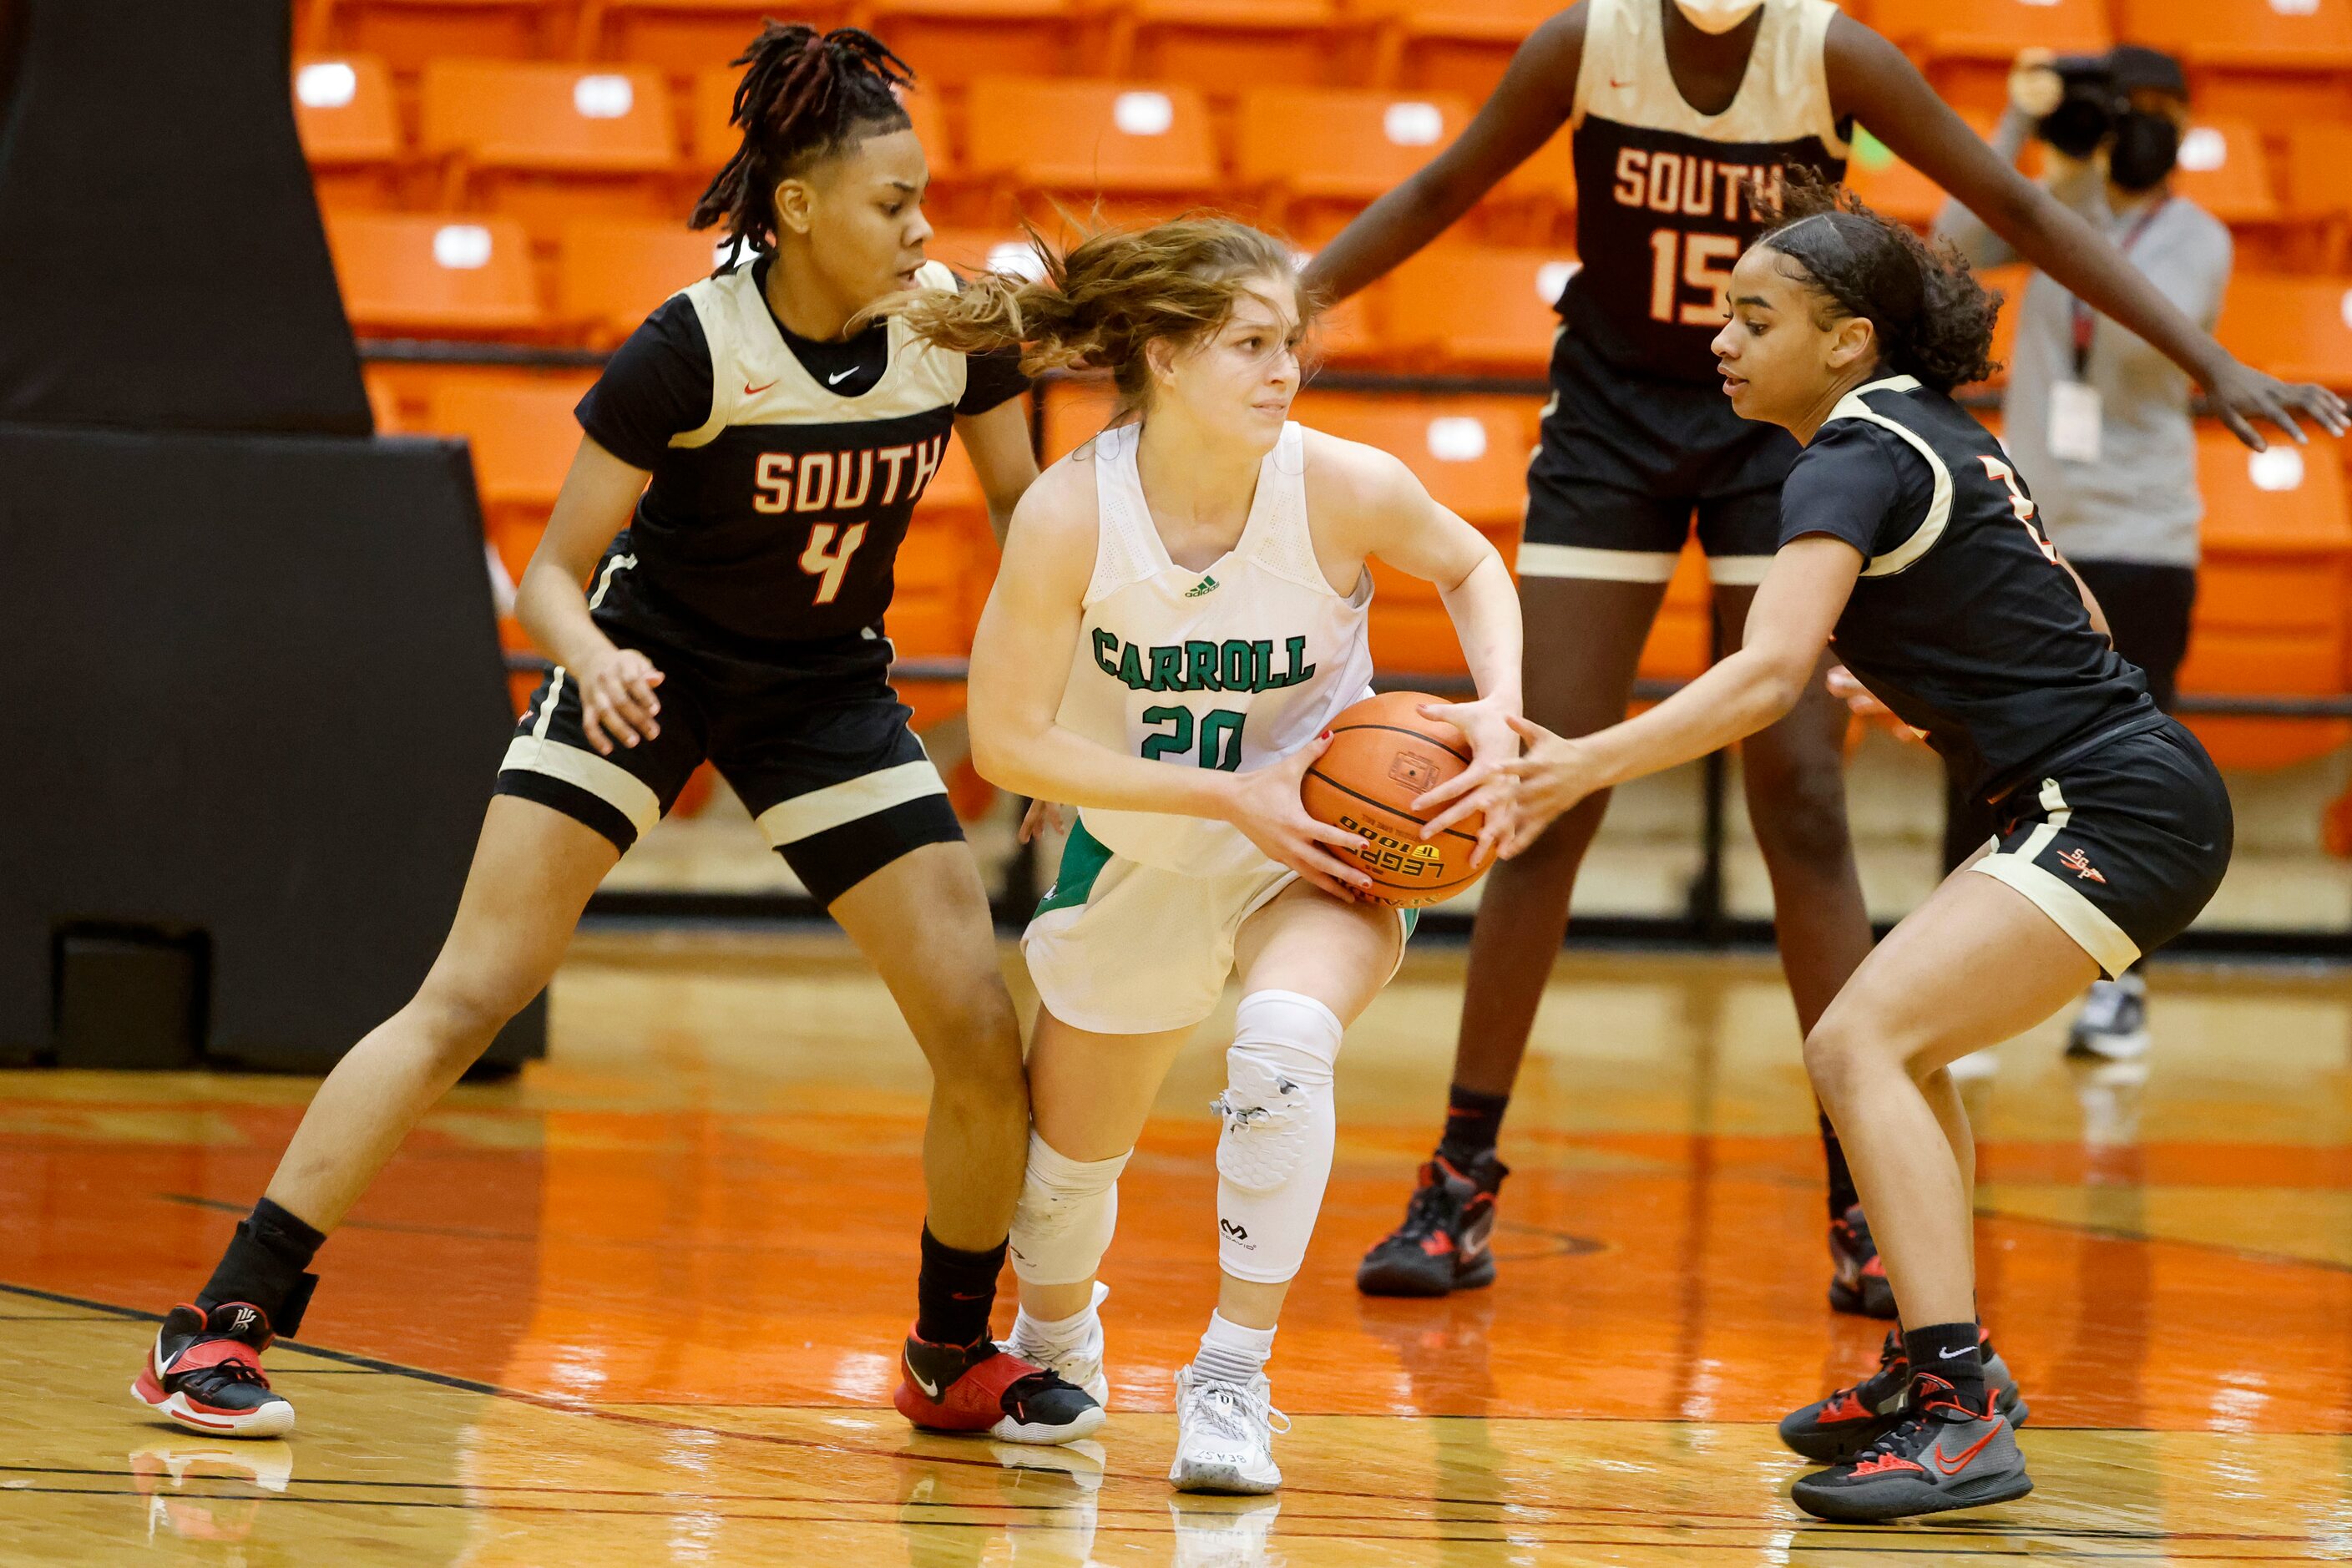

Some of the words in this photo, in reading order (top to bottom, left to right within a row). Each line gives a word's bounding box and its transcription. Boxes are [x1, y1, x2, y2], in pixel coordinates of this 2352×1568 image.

[1612, 146, 1784, 224] SOUTH
[1650, 227, 1741, 328] 15
[752, 434, 943, 514] SOUTH
[798, 519, 870, 606] 4
[1184, 581, 1221, 598] adidas
[1092, 626, 1317, 694] CARROLL
[1141, 706, 1247, 773] 20
[1339, 816, 1411, 852] 1000
